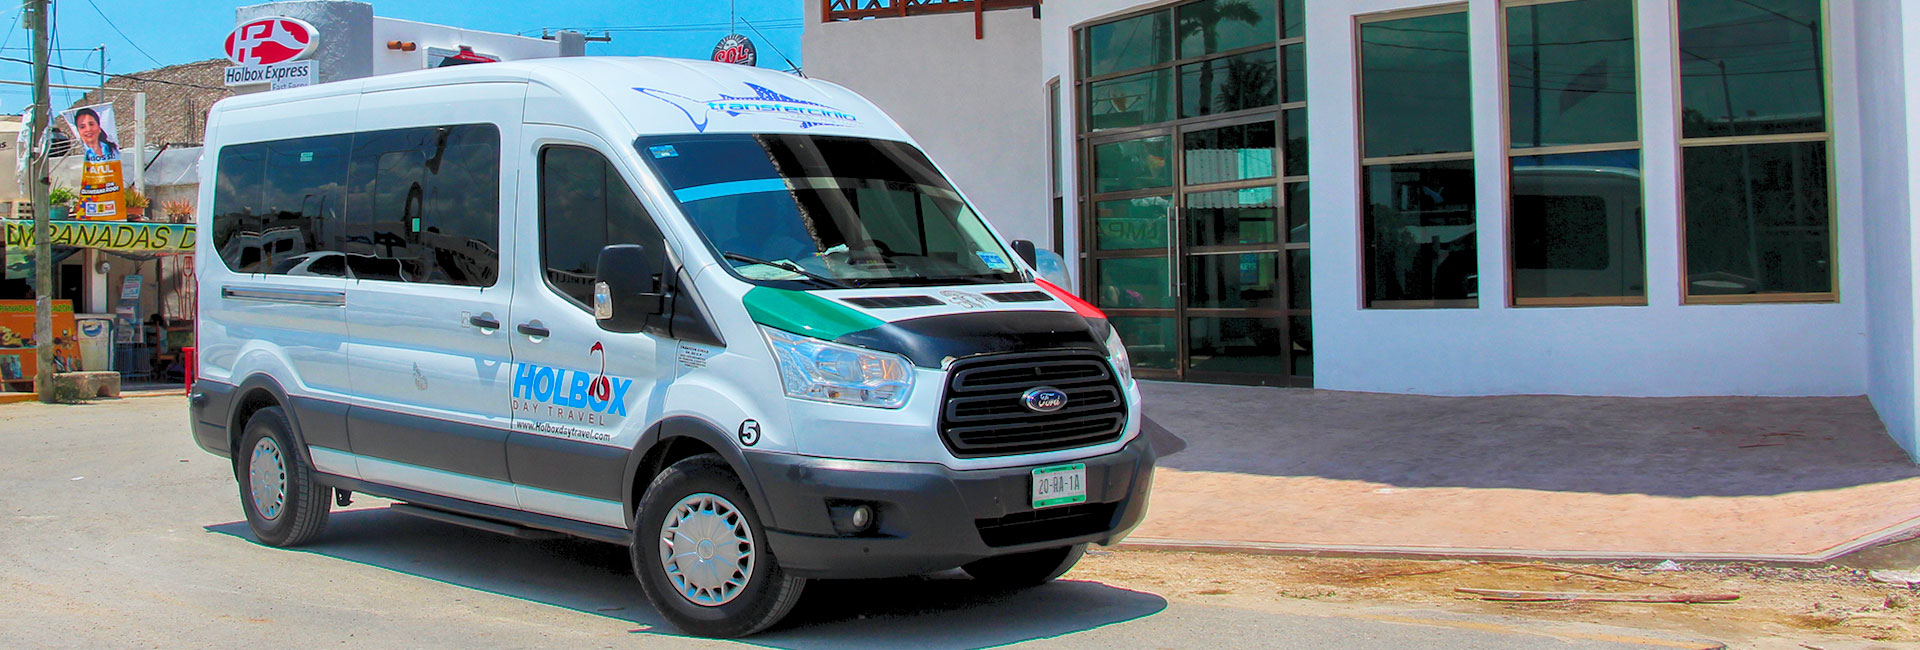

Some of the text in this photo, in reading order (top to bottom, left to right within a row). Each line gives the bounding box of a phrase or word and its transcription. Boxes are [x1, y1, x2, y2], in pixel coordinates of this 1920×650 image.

[226, 64, 309, 83] Holbox Express
[513, 363, 632, 417] HOLBOX
[1038, 392, 1061, 408] Ford
[513, 400, 605, 426] DAY TRAVEL
[516, 421, 611, 442] www.Holboxdaytravel.com
[741, 420, 758, 444] 5
